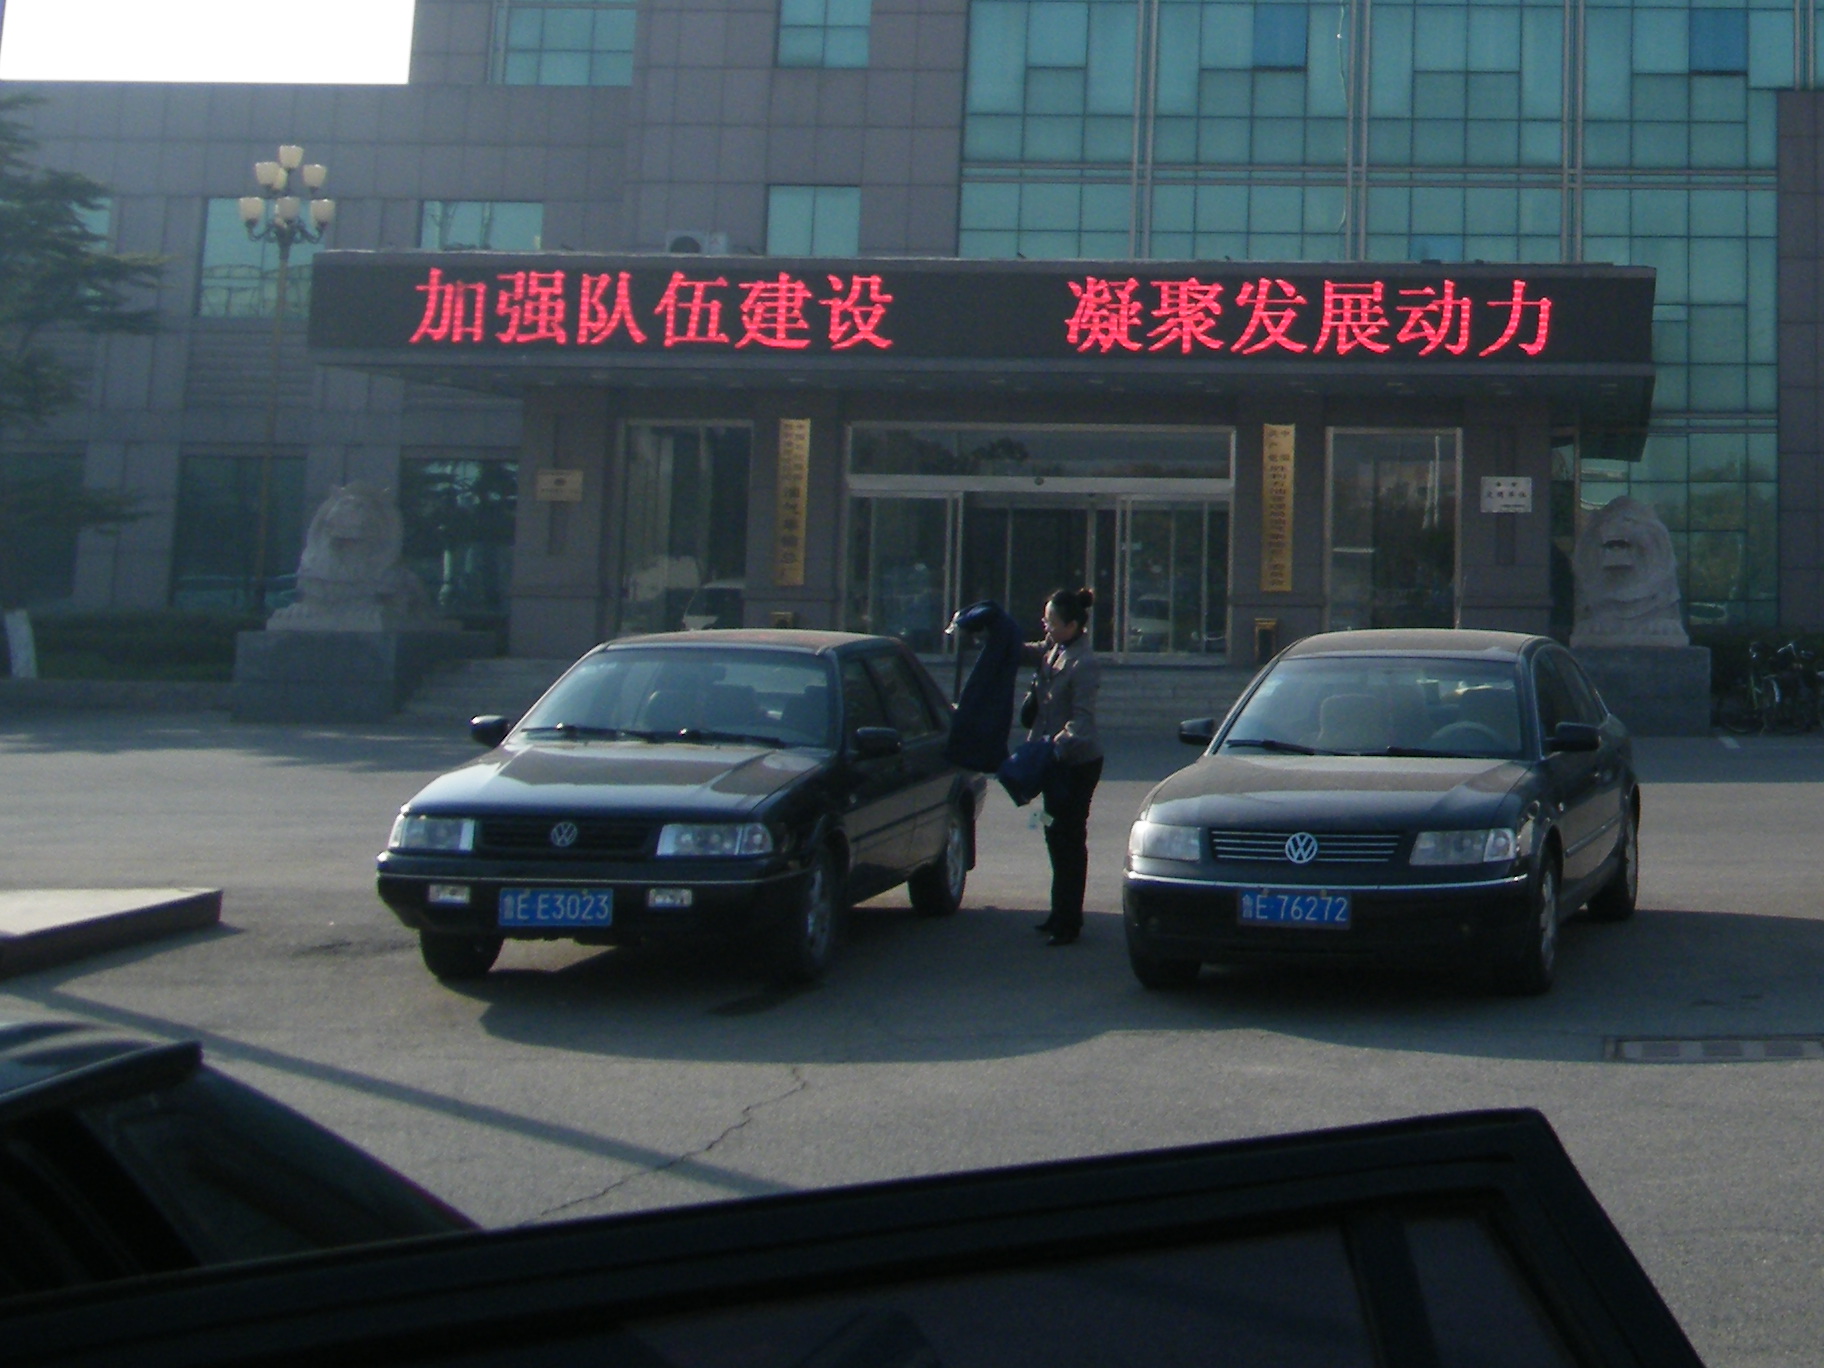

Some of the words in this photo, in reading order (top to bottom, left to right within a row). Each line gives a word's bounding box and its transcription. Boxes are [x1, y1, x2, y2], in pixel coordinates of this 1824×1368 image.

[409, 267, 894, 351] 加强队伍建设
[1064, 275, 1554, 358] 凝聚发展动力
